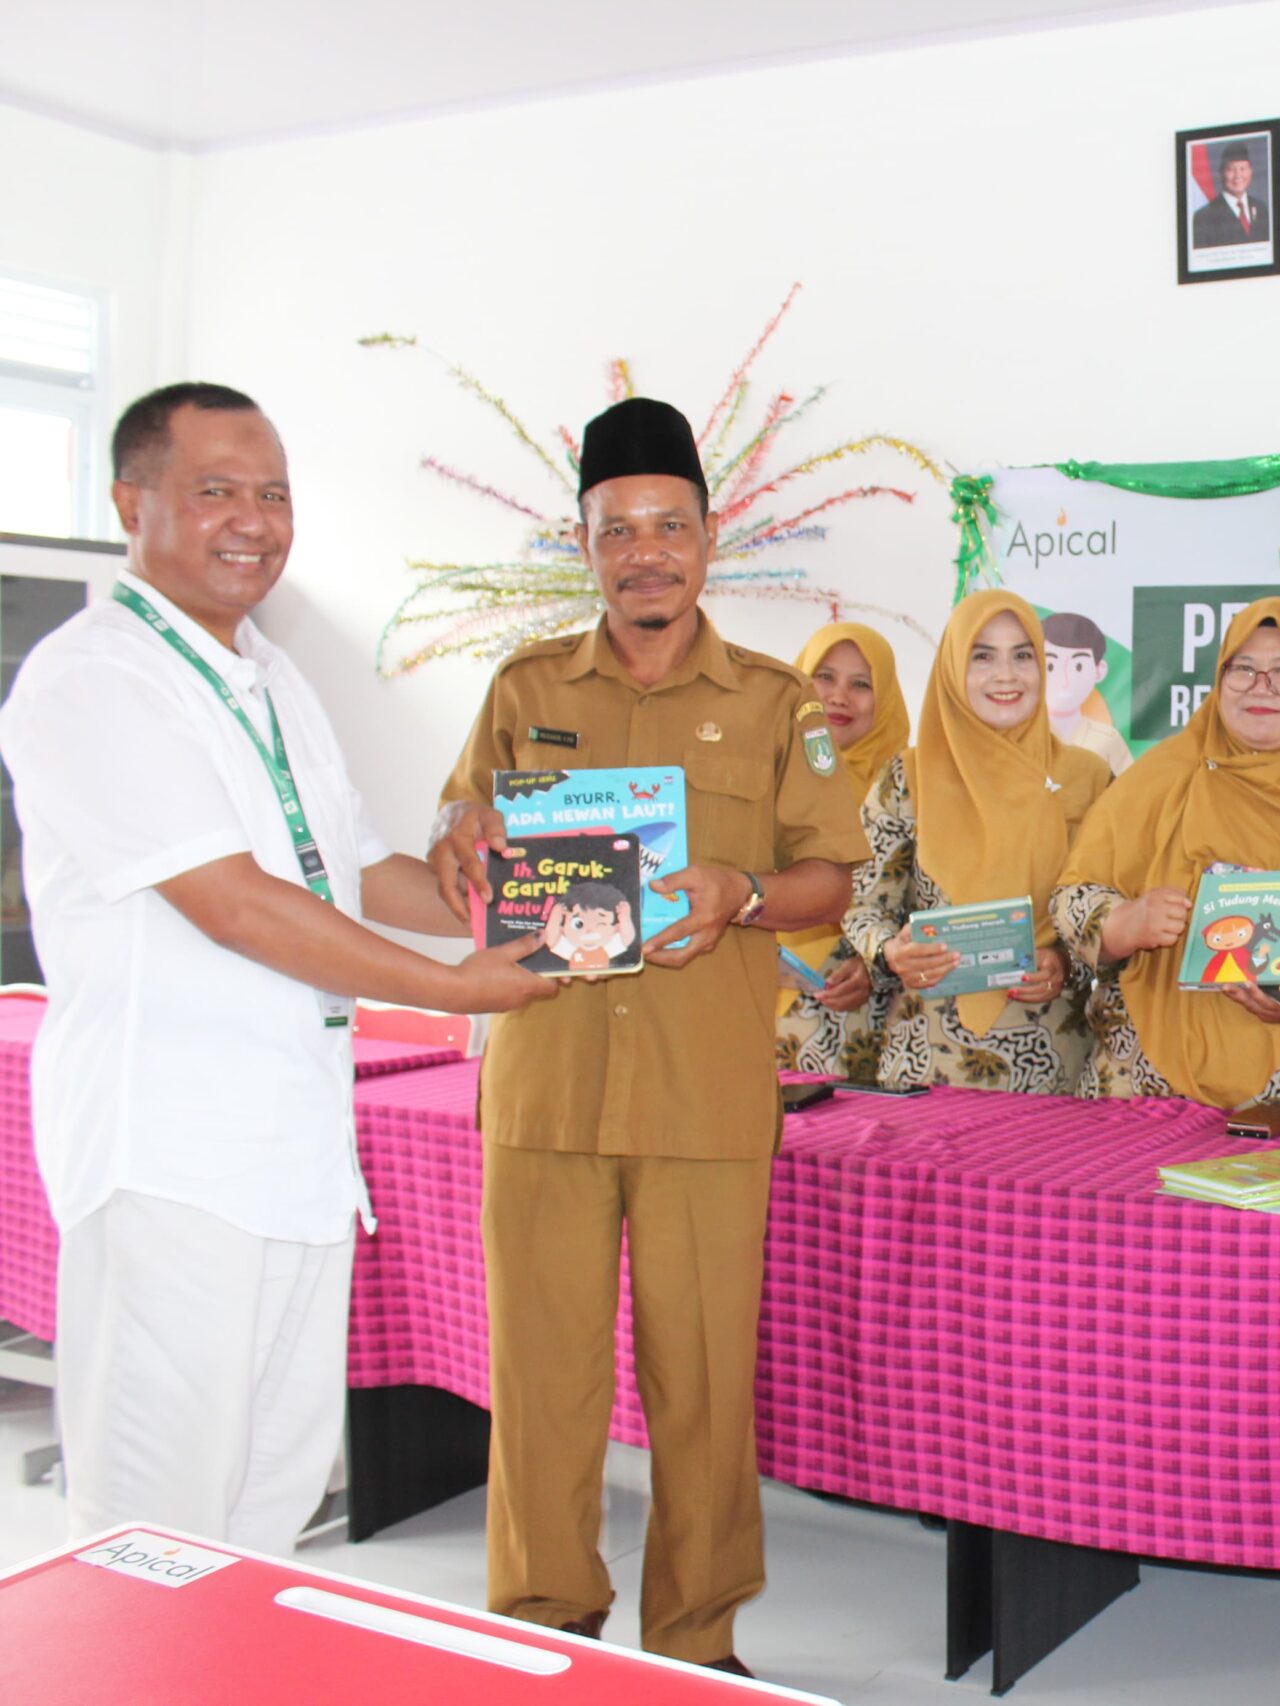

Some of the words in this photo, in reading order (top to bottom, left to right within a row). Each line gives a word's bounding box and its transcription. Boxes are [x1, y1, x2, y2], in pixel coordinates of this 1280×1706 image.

[1007, 509, 1116, 569] Apical
[507, 811, 546, 827] ADA
[552, 806, 615, 824] HEWAN
[622, 802, 675, 819] LAUT!
[537, 858, 613, 879] Garuk-
[502, 877, 570, 899] Garuk
[498, 896, 554, 921] Mulu!
[1203, 901, 1215, 915] Si
[1217, 894, 1260, 908] Tudung
[91, 1542, 216, 1581] Apical
